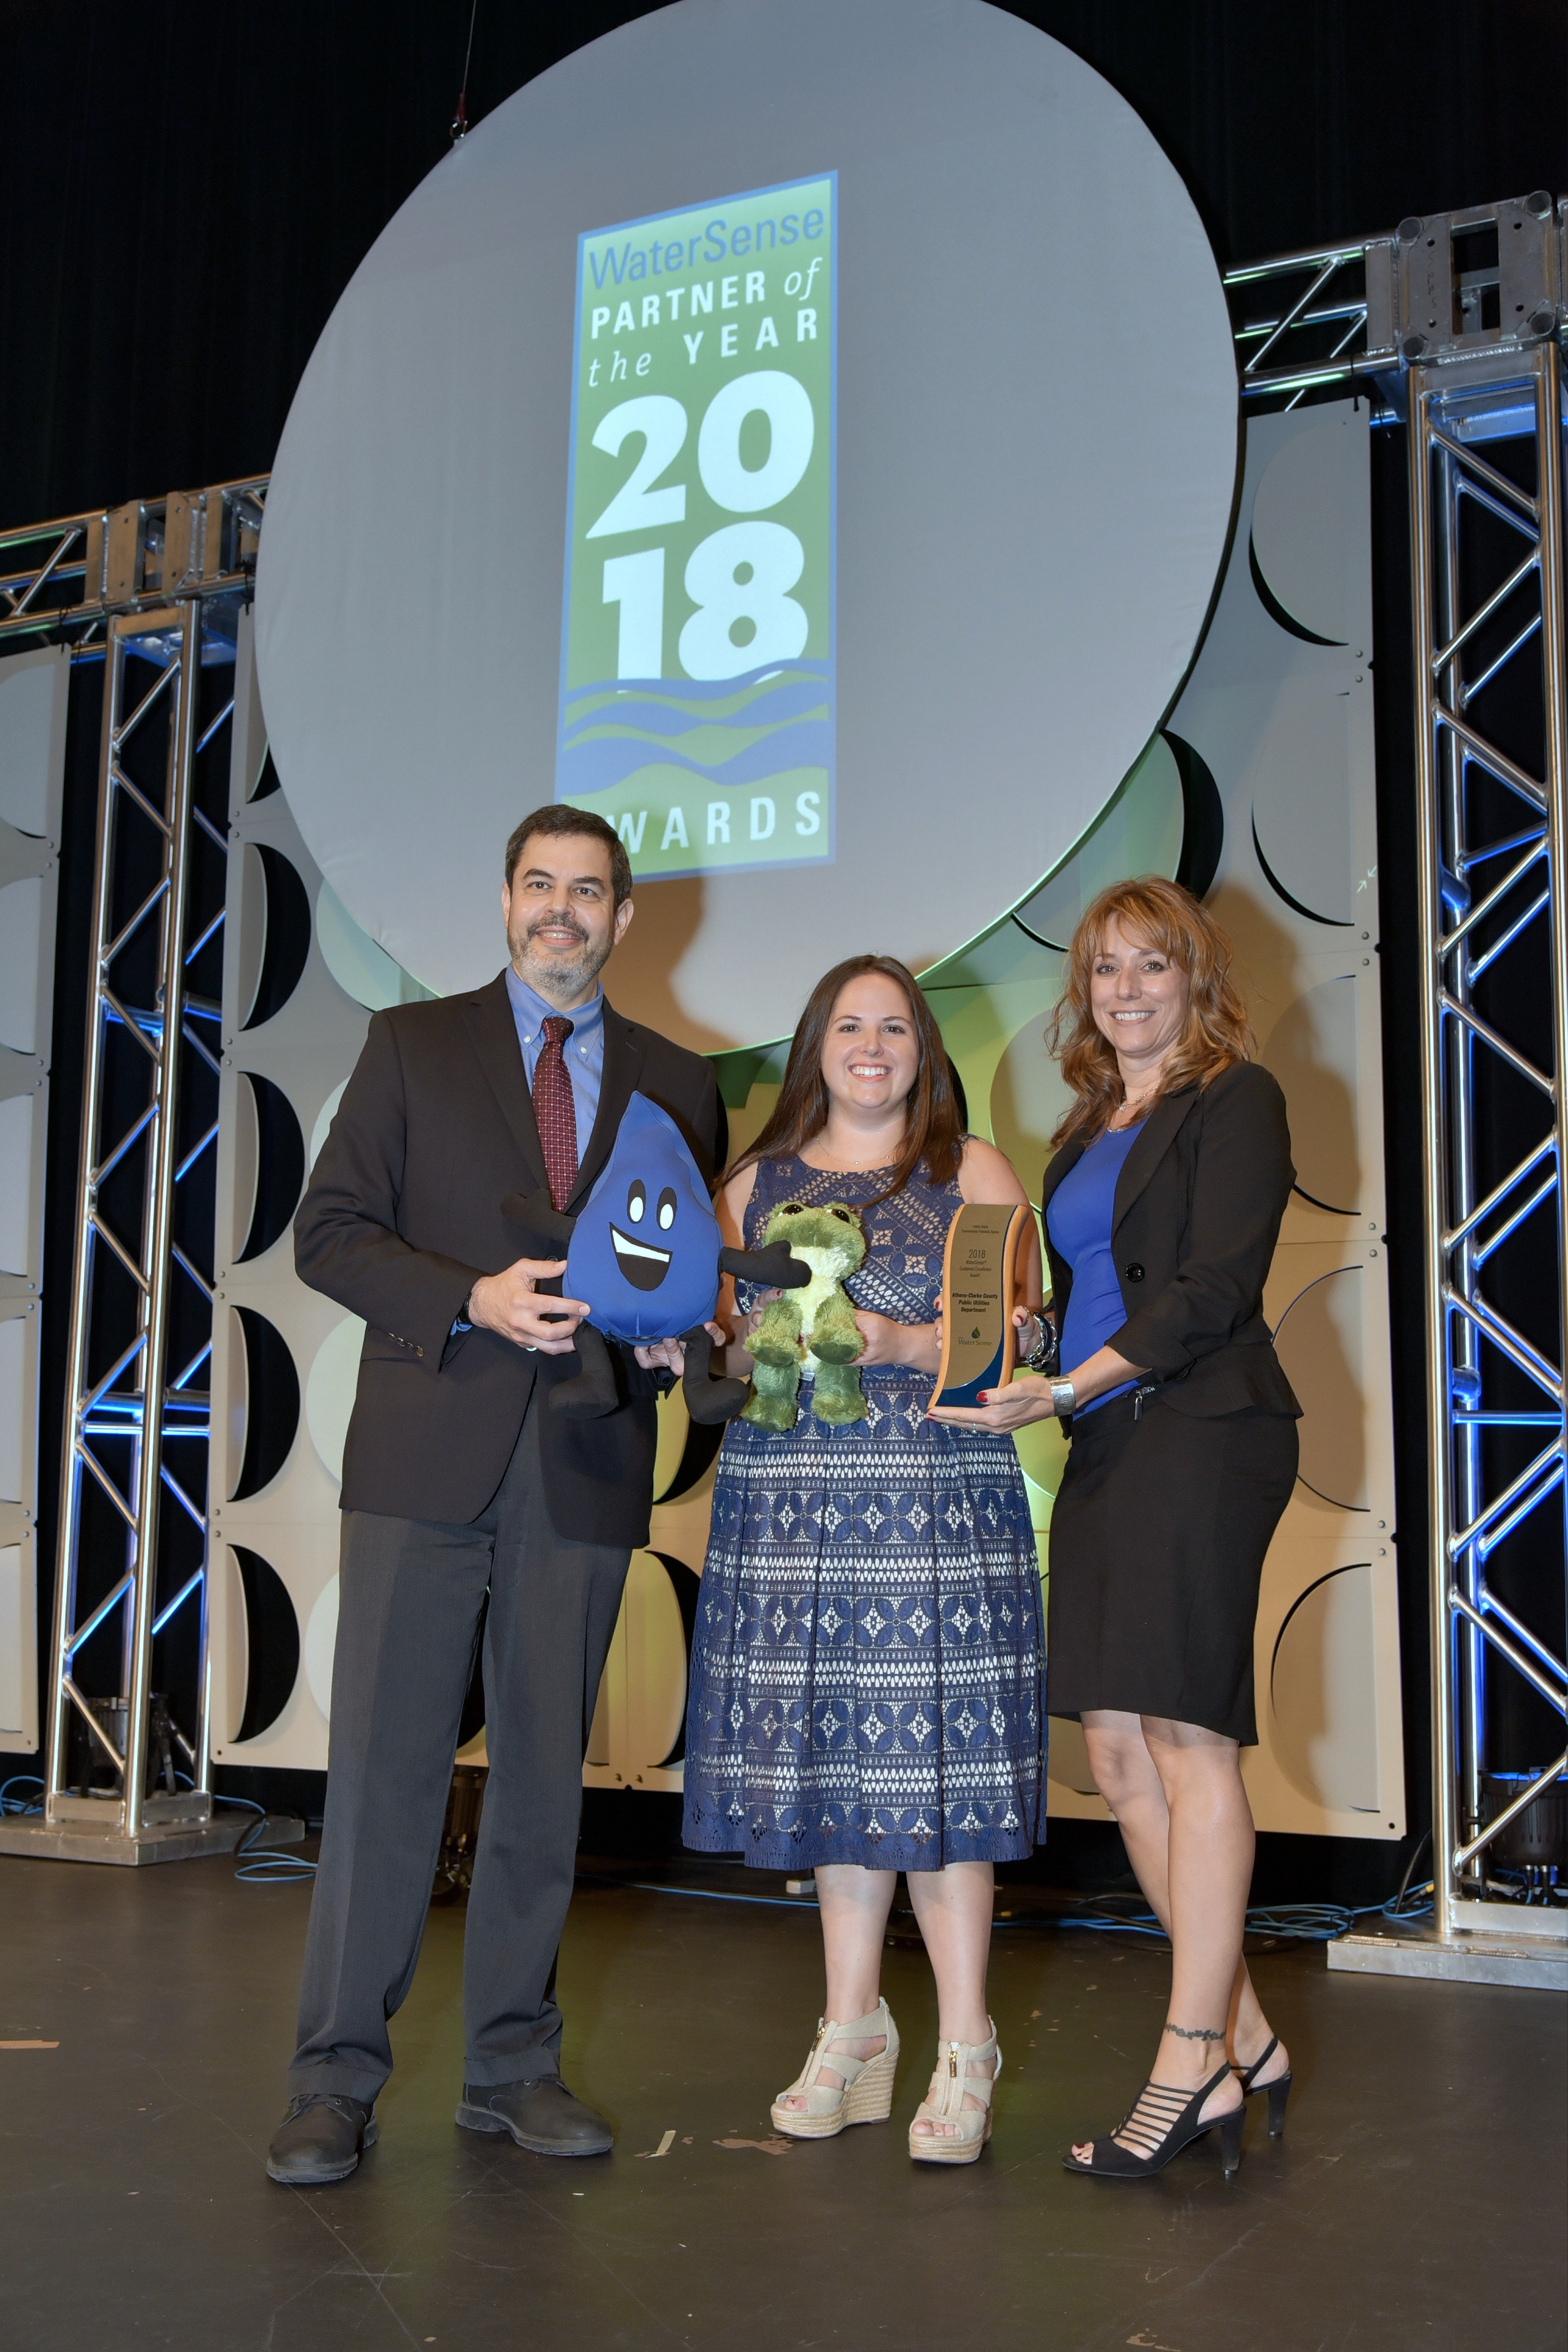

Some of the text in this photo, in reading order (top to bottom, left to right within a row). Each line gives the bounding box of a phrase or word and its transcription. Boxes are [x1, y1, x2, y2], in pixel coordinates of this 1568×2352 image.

[590, 208, 824, 290] WaterSense
[591, 257, 823, 339] PARTNER of
[588, 308, 817, 388] the YEAR
[586, 370, 814, 539] 20
[602, 521, 808, 694] 18
[607, 791, 820, 855] WARDS
[969, 1249, 986, 1258] 2018
